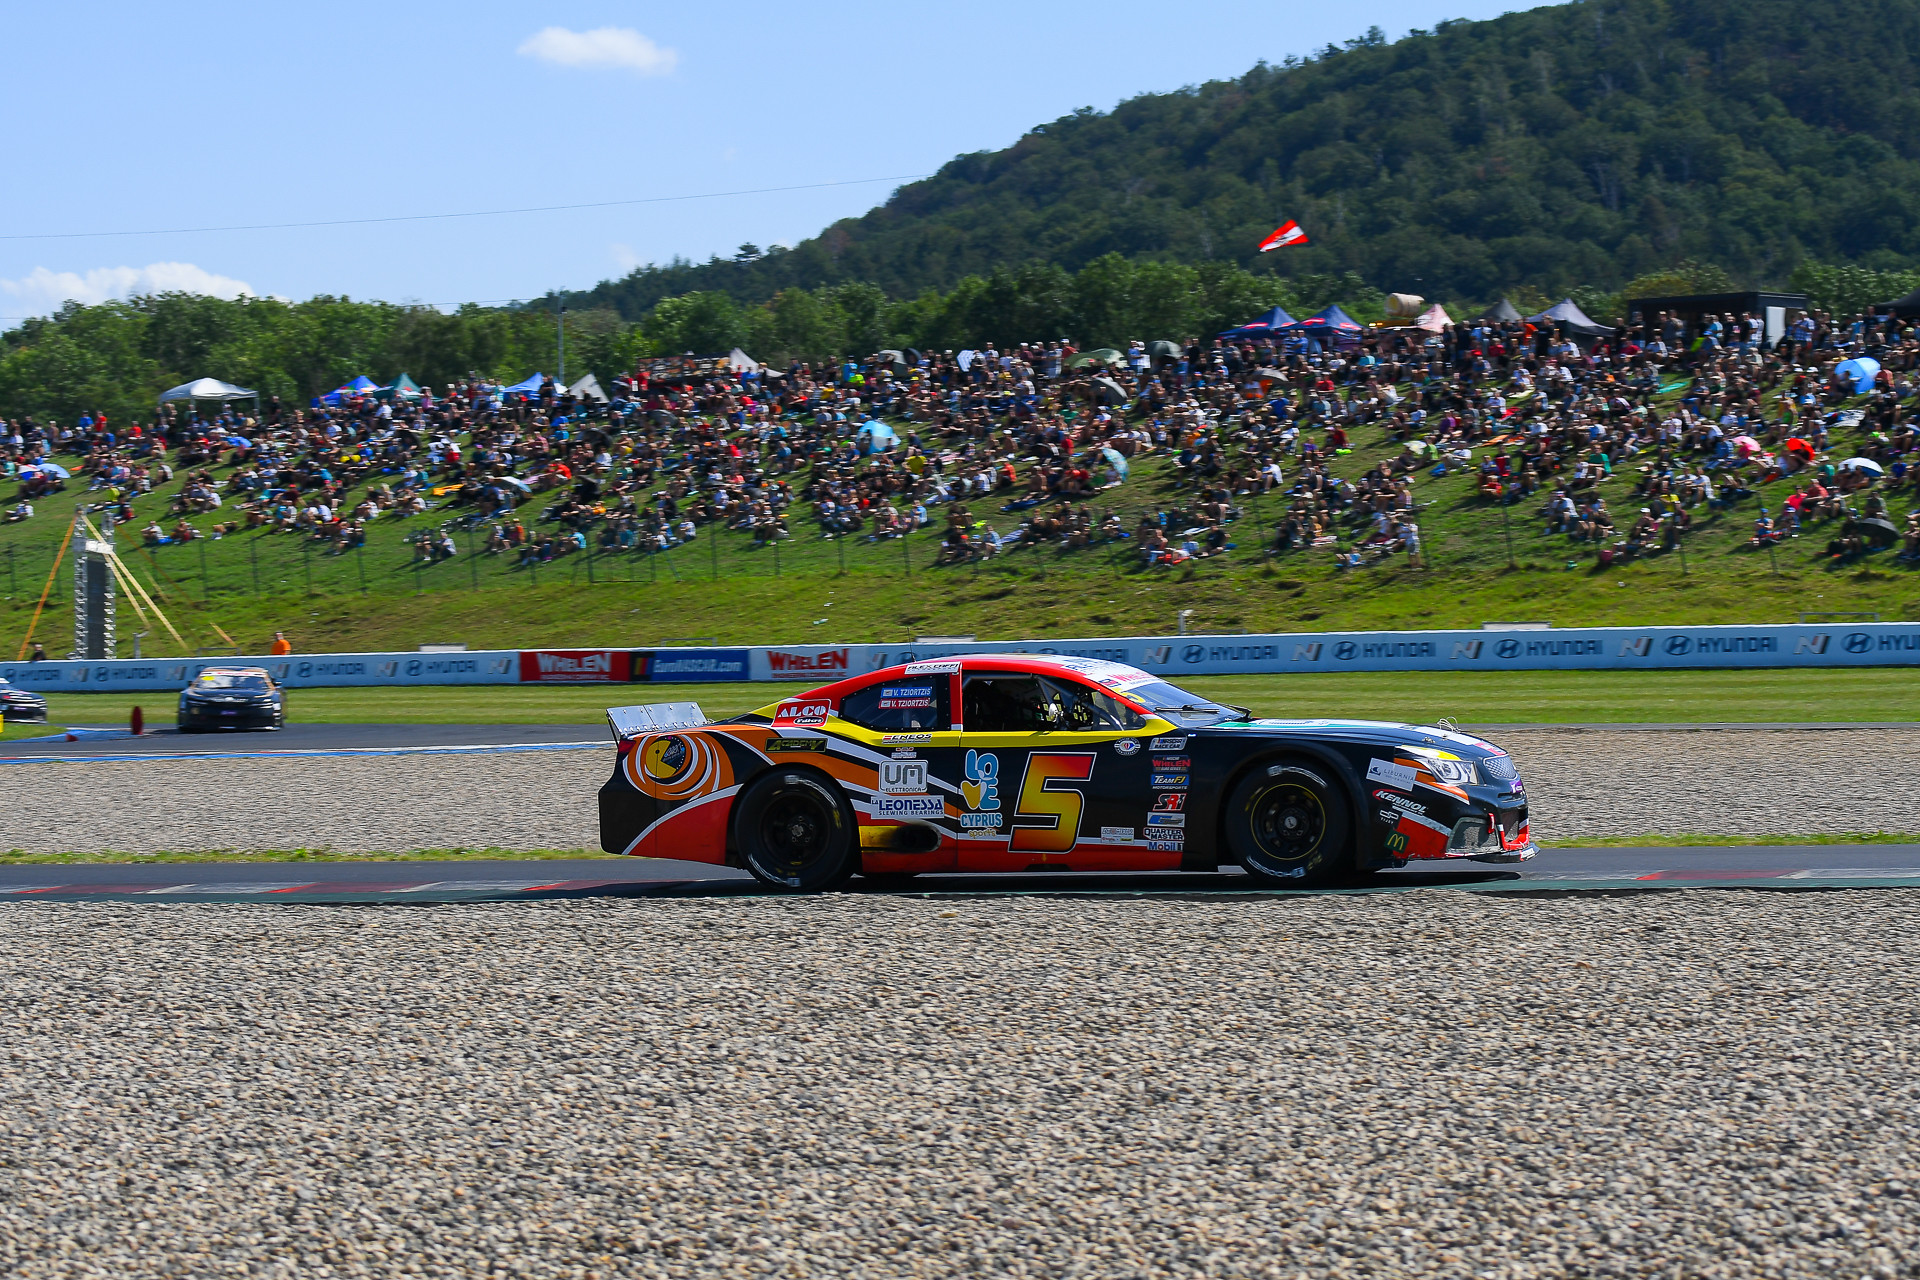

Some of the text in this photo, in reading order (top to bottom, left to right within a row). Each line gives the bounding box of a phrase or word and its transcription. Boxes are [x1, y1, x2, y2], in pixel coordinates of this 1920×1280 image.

[1209, 645, 1279, 660] HYUNDAI
[1362, 642, 1437, 658] HYUNDAI
[1526, 640, 1604, 656] HYUNDAI
[1697, 637, 1777, 653] HYUNDAI
[537, 653, 612, 672] WHELEN
[766, 648, 850, 671] WHELEN
[901, 688, 930, 696] TZIORTZIS
[899, 699, 928, 707] TZIORTZIS
[778, 706, 827, 718] ALCO
[1152, 759, 1191, 767] WHELEN
[885, 764, 923, 785] UM
[1384, 768, 1414, 781] LIBURNIA
[879, 799, 943, 811] LEONESSA
[1008, 752, 1097, 854] 5
[1375, 790, 1427, 814] KENNOL
[961, 813, 1003, 828] CYPRUS
[968, 828, 997, 838] sports
[1144, 828, 1182, 836] QUARTER
[1148, 842, 1176, 851] Mobil
